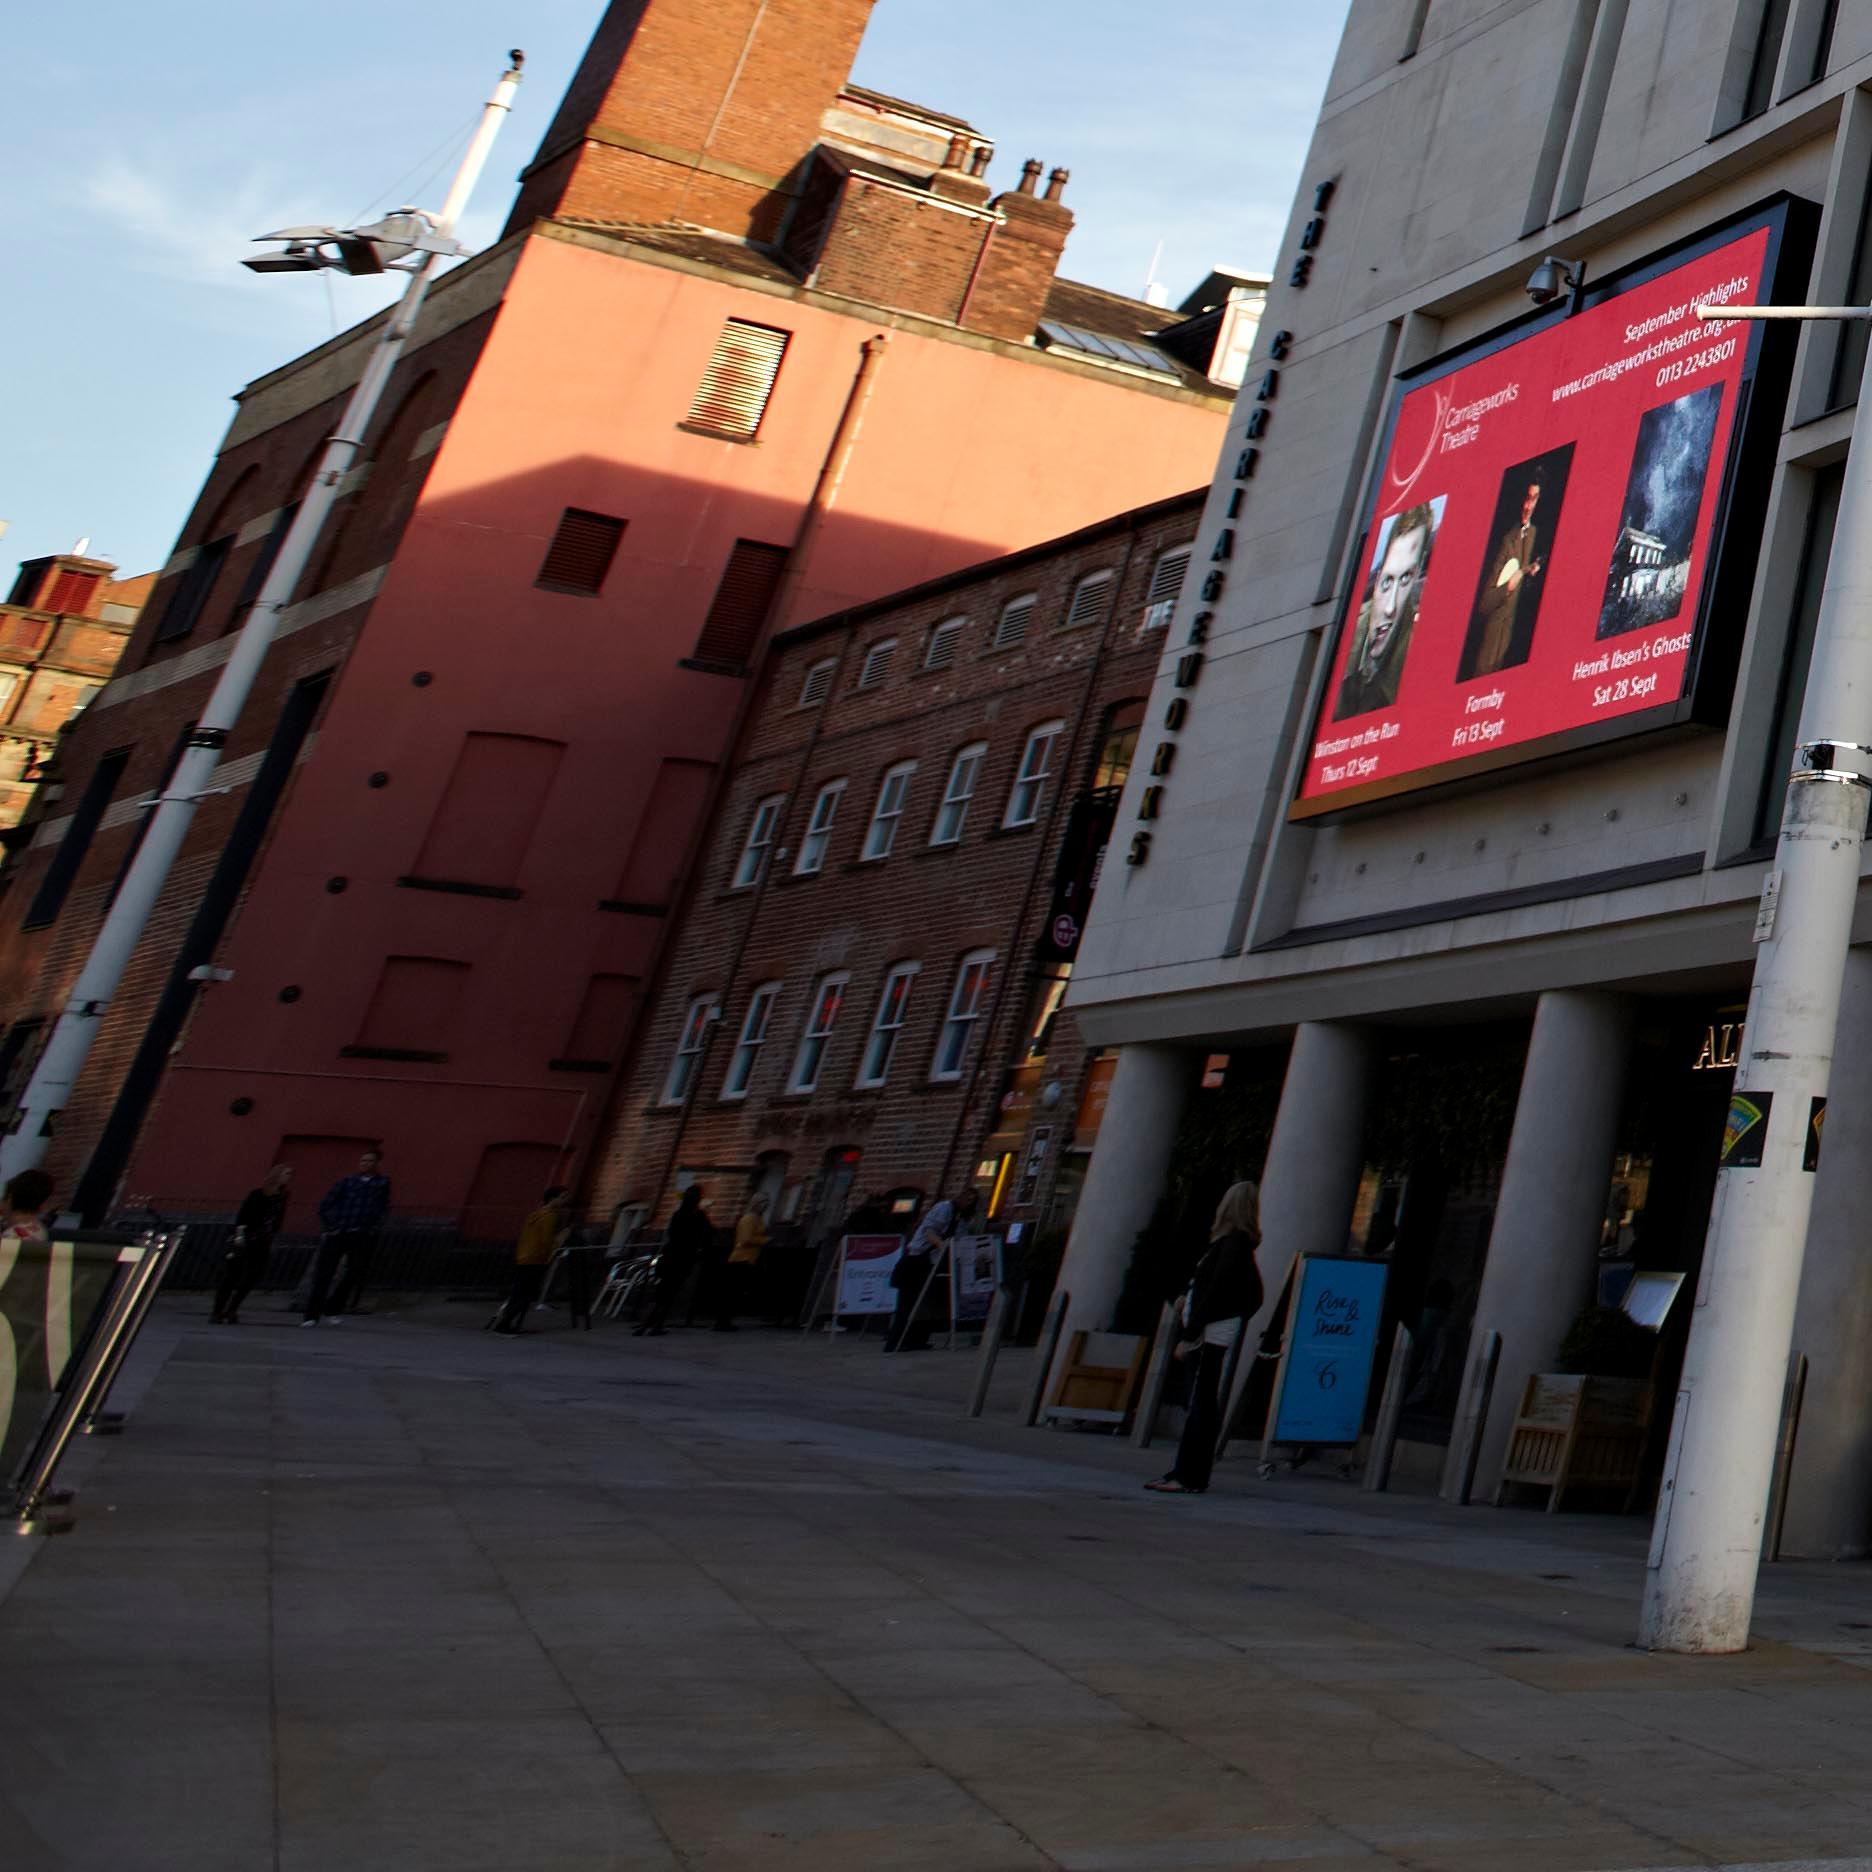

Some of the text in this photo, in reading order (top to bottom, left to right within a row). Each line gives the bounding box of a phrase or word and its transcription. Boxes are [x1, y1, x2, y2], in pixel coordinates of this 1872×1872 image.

[1624, 303, 1688, 343] September
[1552, 318, 1741, 402] www.carriageworkstheatre.org.u
[1656, 338, 1737, 388] 0113 2243801
[1445, 382, 1520, 429] Carriageworks
[1440, 424, 1480, 454] Theatre
[1572, 632, 1692, 681] Henrik Ibsen's Ghosts
[1465, 688, 1505, 714] Formby
[1592, 672, 1658, 707] Sat 28 Sept
[1452, 718, 1505, 747] Fri 13 Sept
